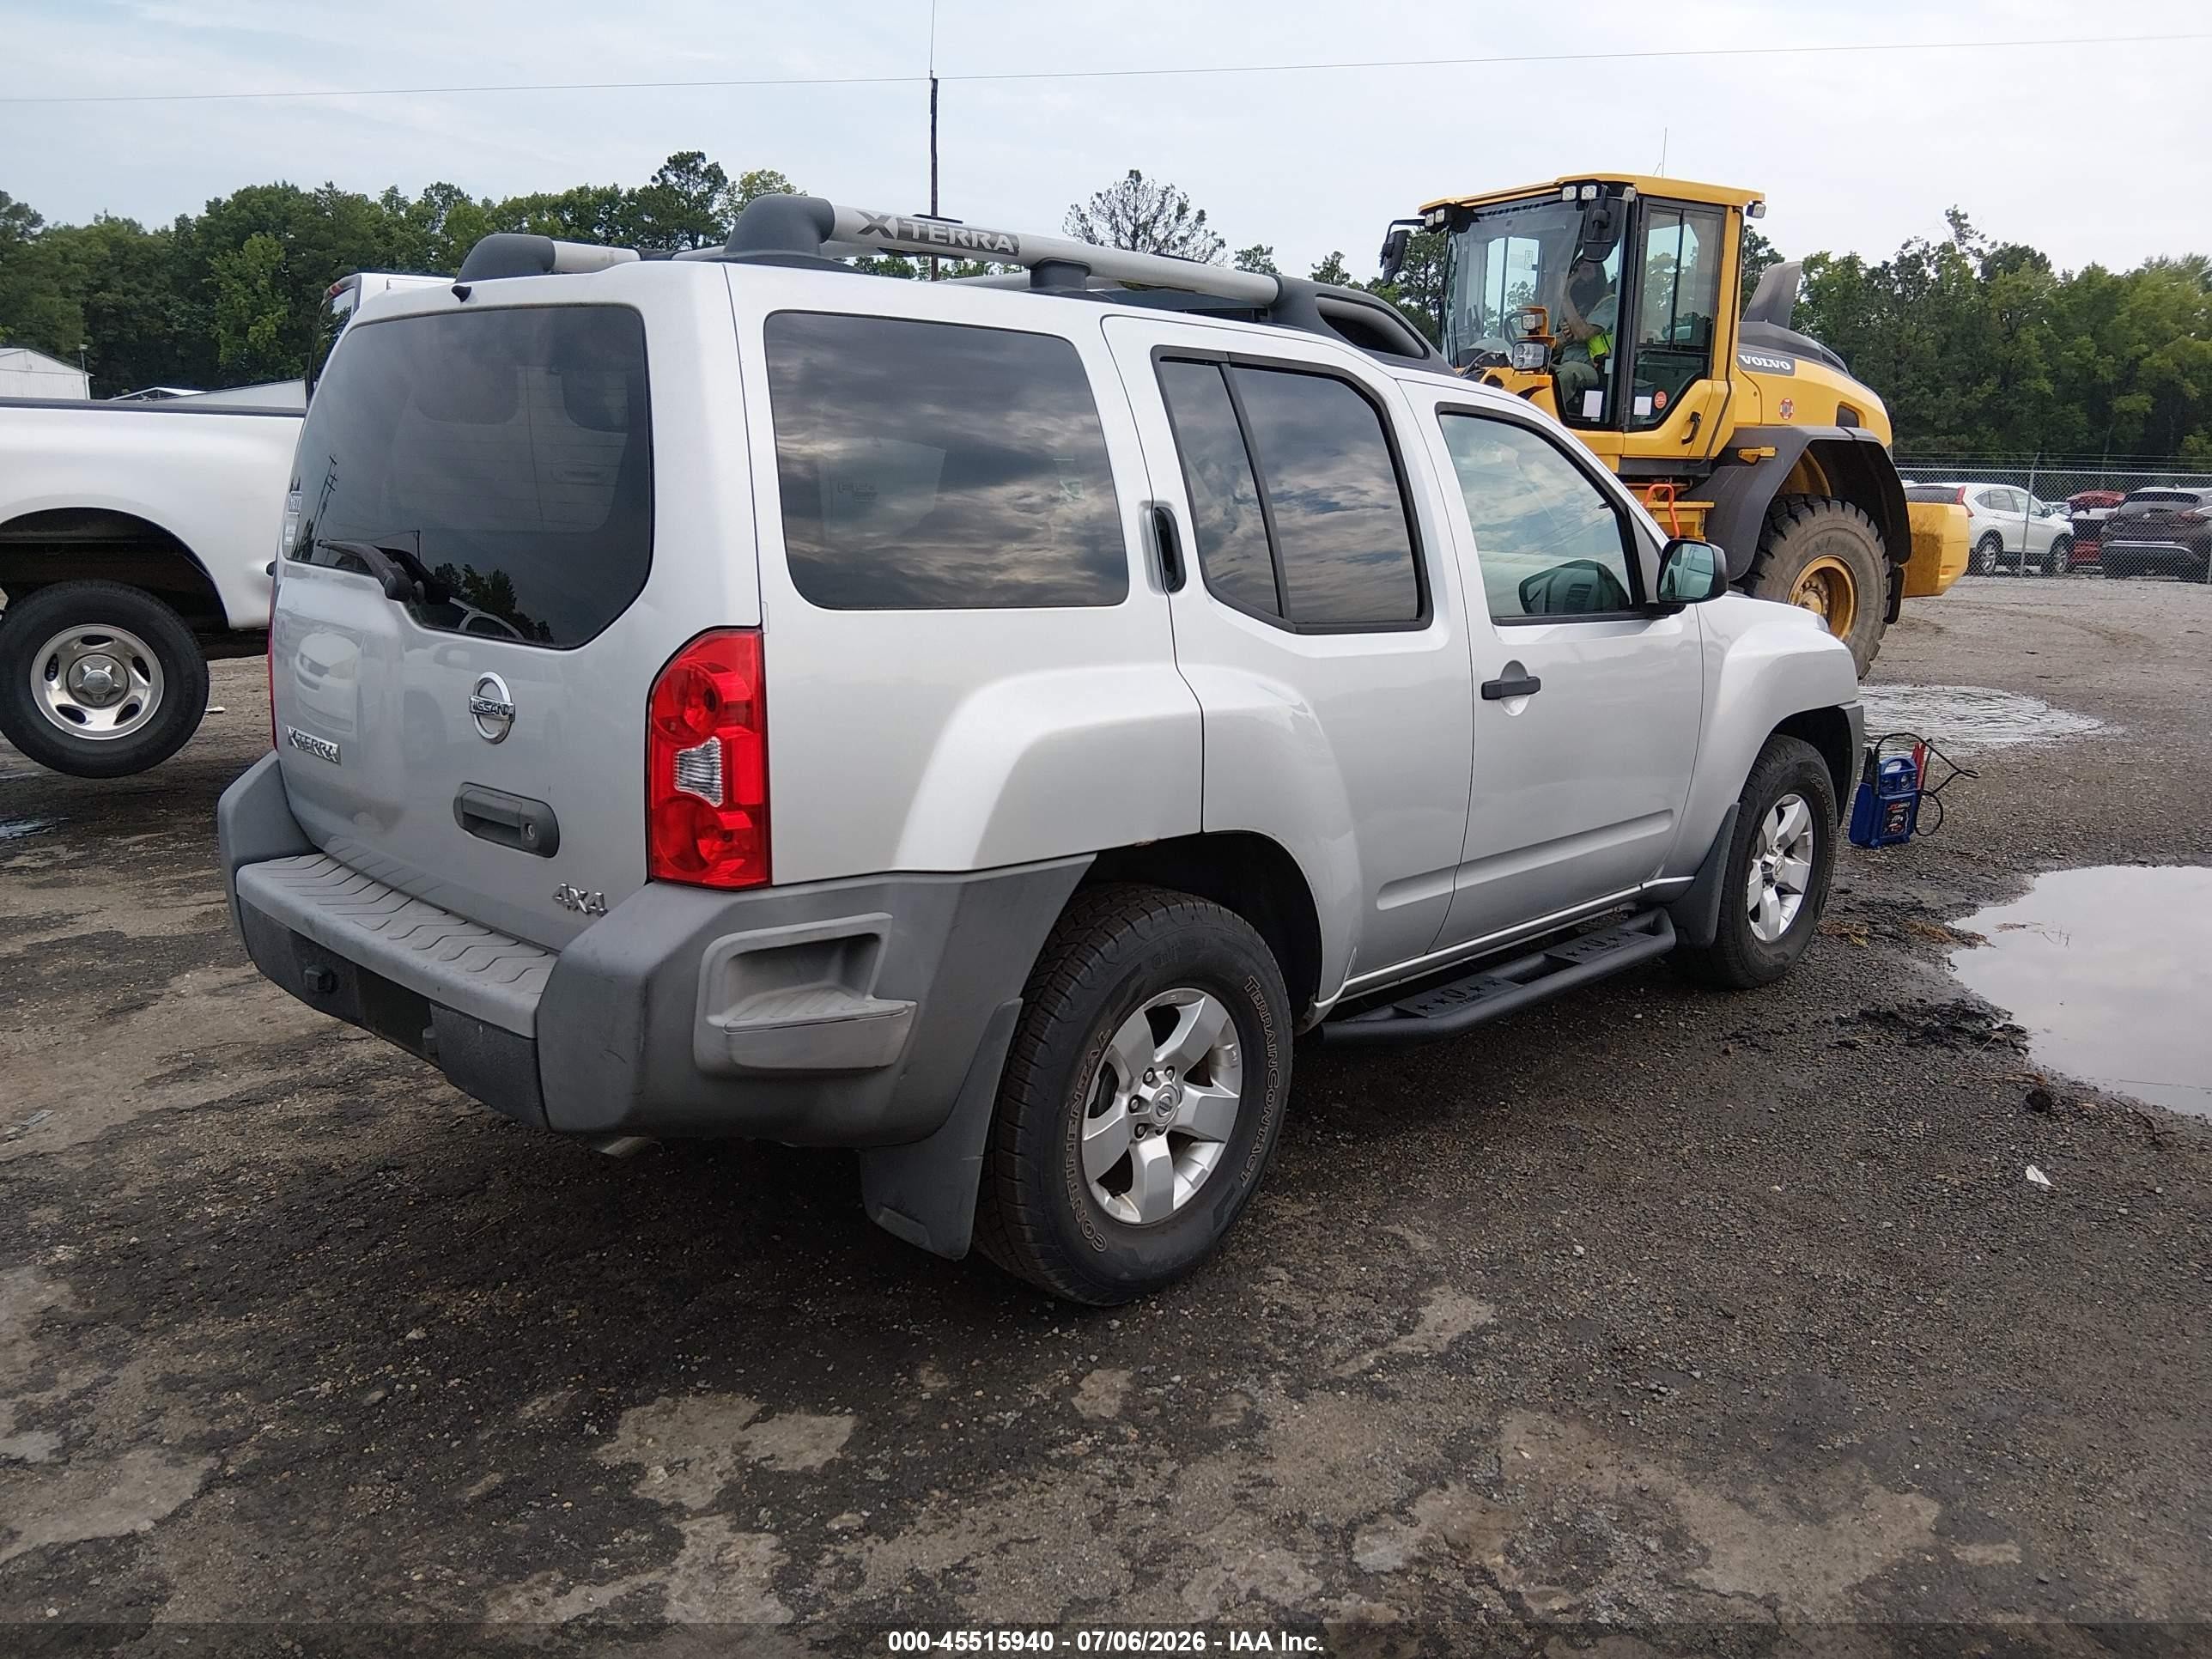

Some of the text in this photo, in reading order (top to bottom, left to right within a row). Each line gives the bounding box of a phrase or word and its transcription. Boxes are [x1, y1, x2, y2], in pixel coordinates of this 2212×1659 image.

[855, 210, 1018, 256] XTERRA
[1737, 354, 1792, 370] VOLVO
[471, 696, 511, 717] NISSAN
[286, 725, 341, 766] XTERRA
[1065, 1028, 1112, 1253] CONTINENTAL
